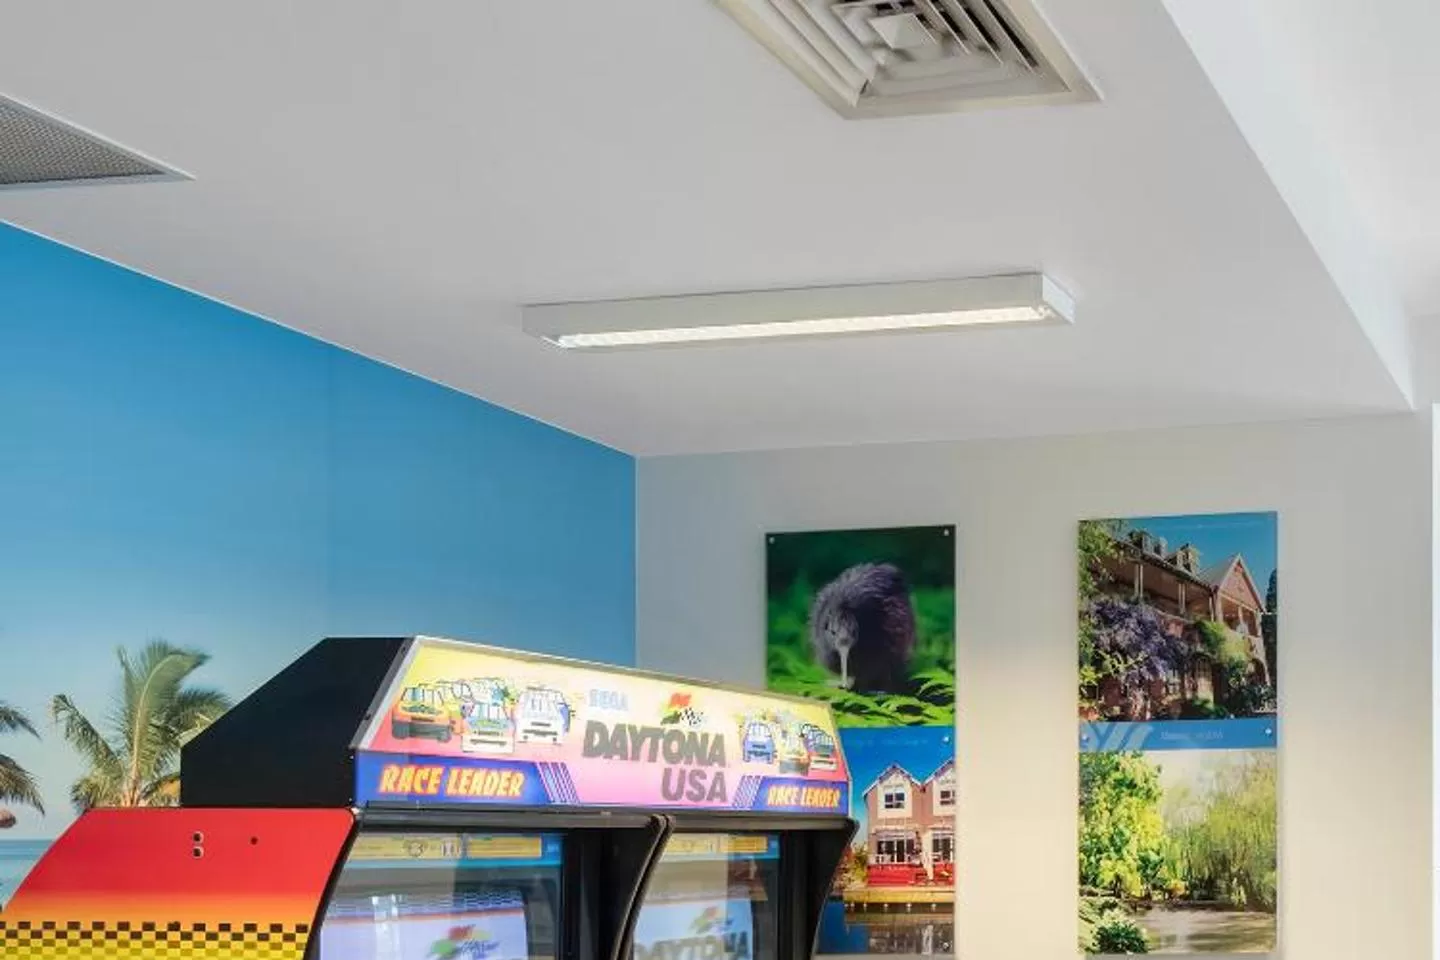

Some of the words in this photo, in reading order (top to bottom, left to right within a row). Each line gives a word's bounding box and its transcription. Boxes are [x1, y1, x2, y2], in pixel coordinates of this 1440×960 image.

[582, 719, 727, 768] DAYTONA
[378, 763, 445, 796] RACE
[446, 766, 525, 798] LEADER
[661, 767, 728, 803] USA
[767, 784, 800, 807] RACE
[801, 786, 842, 809] LEADER
